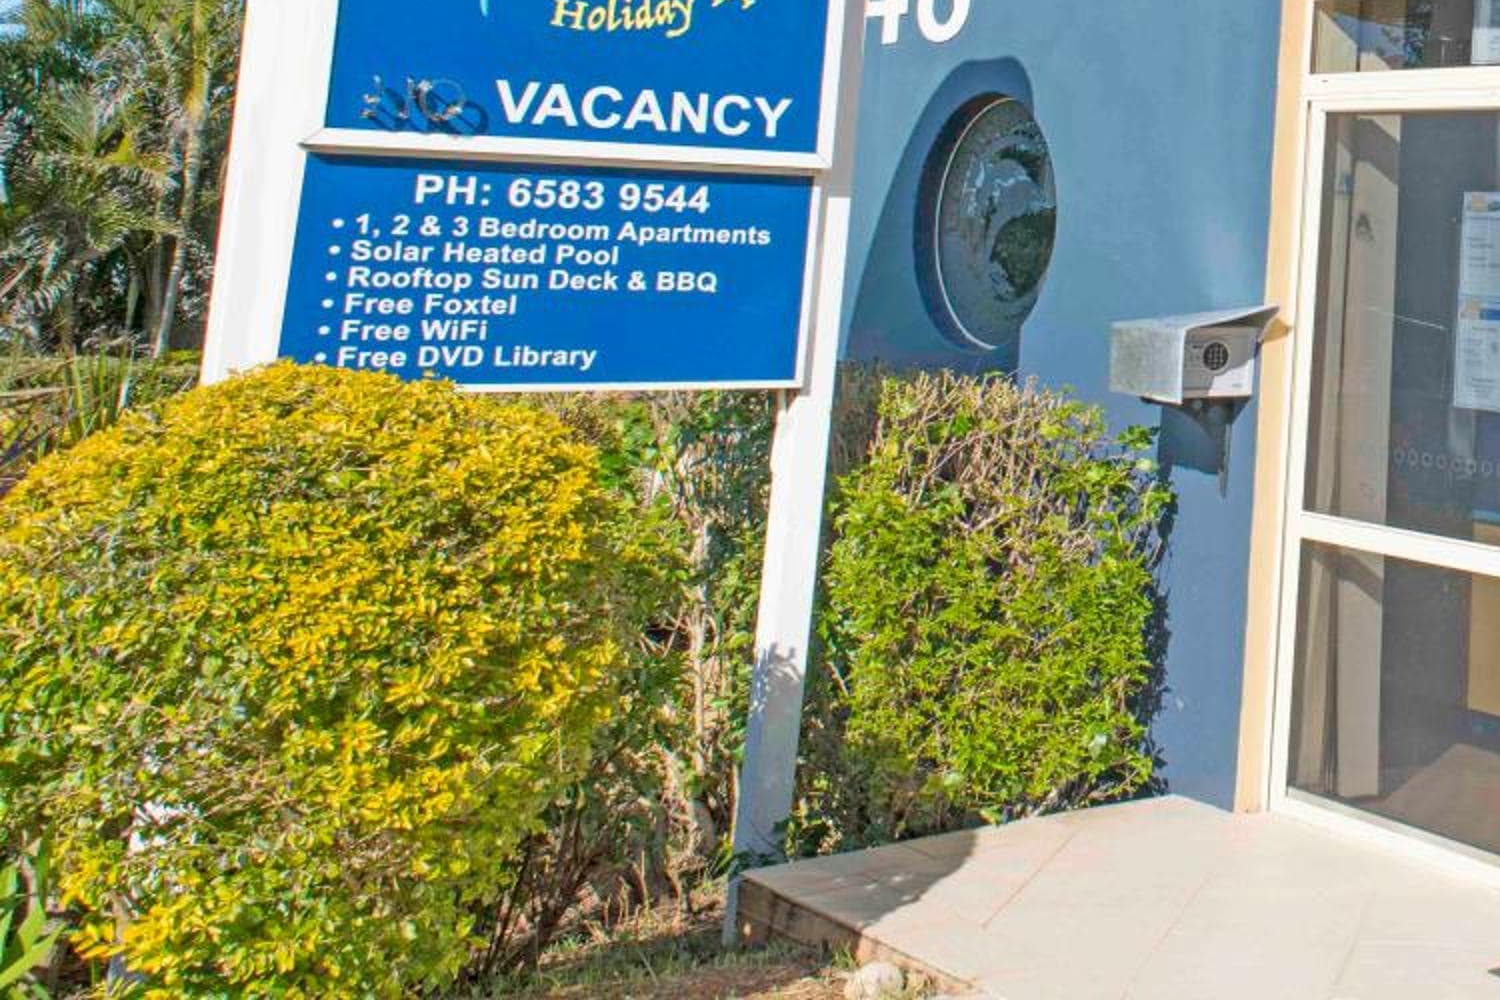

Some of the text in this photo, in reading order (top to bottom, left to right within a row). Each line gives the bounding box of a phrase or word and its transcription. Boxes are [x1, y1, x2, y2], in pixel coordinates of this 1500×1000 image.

[495, 79, 793, 138] VACANCY
[414, 173, 710, 213] PH: 6583 9544
[356, 214, 771, 245] 1, 2 & 3 Bedroom Apartments
[351, 240, 619, 265] Solar Heated Pool
[347, 266, 717, 293] Rooftop Sun Deck & BBQ
[344, 293, 517, 316] Free Foxtel
[340, 319, 488, 341] Free WiFi
[337, 346, 597, 371] Free DVD Library
